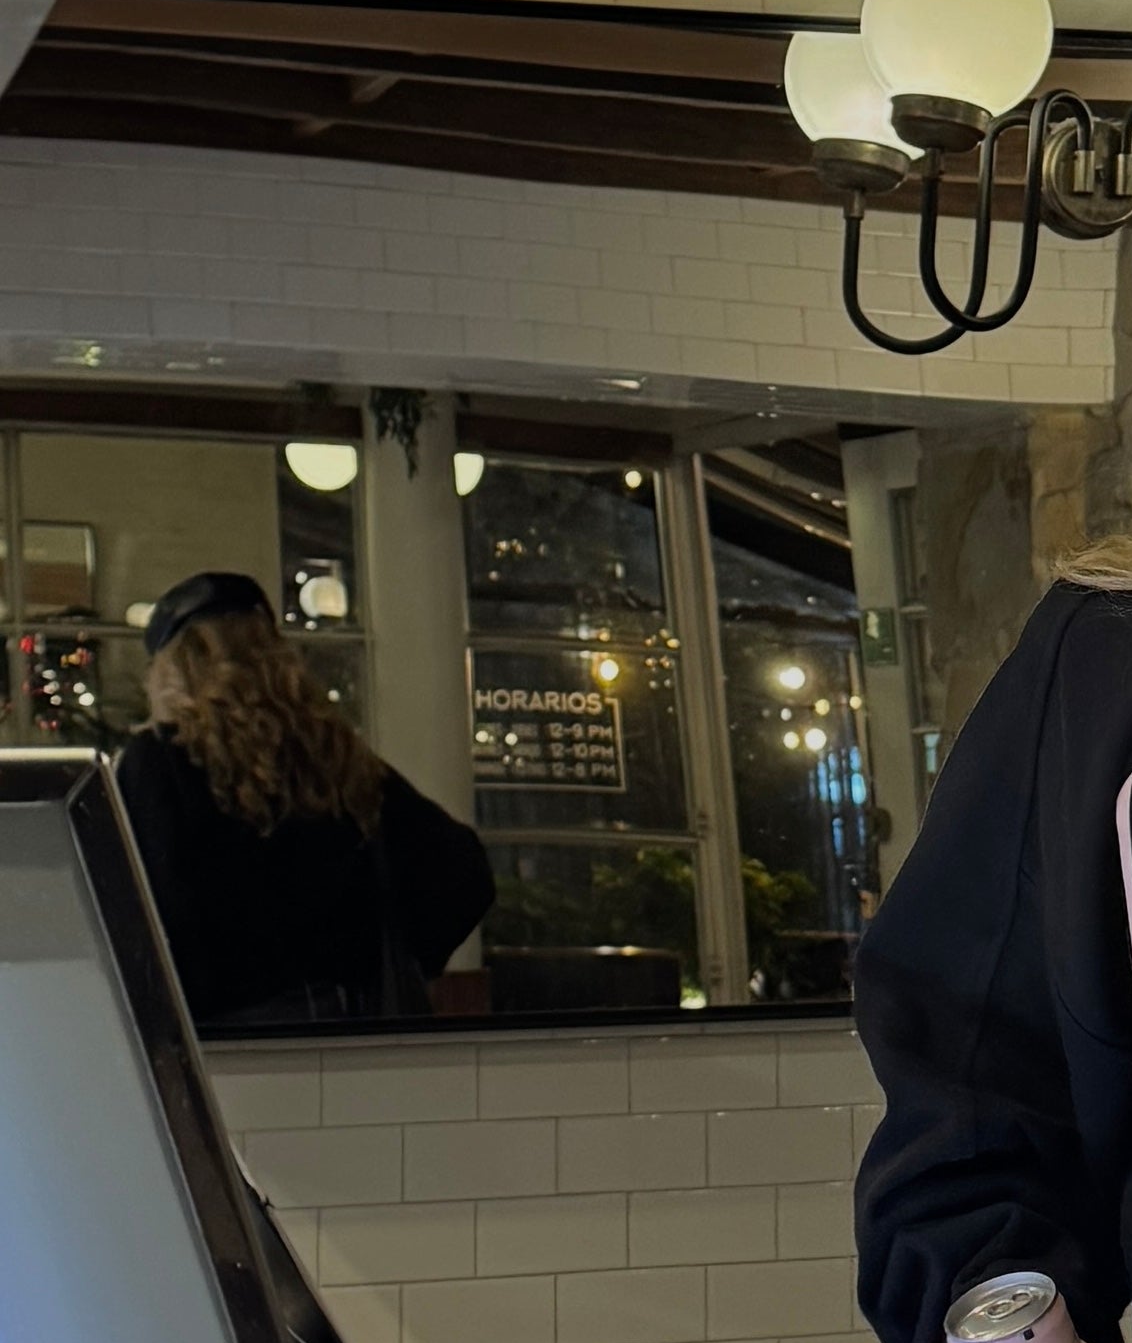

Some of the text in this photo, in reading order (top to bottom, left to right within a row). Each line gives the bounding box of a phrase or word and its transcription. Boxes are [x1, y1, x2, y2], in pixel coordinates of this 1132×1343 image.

[474, 689, 602, 714] HORARIOS
[588, 724, 613, 740] PM
[589, 744, 614, 759] PM
[591, 762, 616, 777] PM
